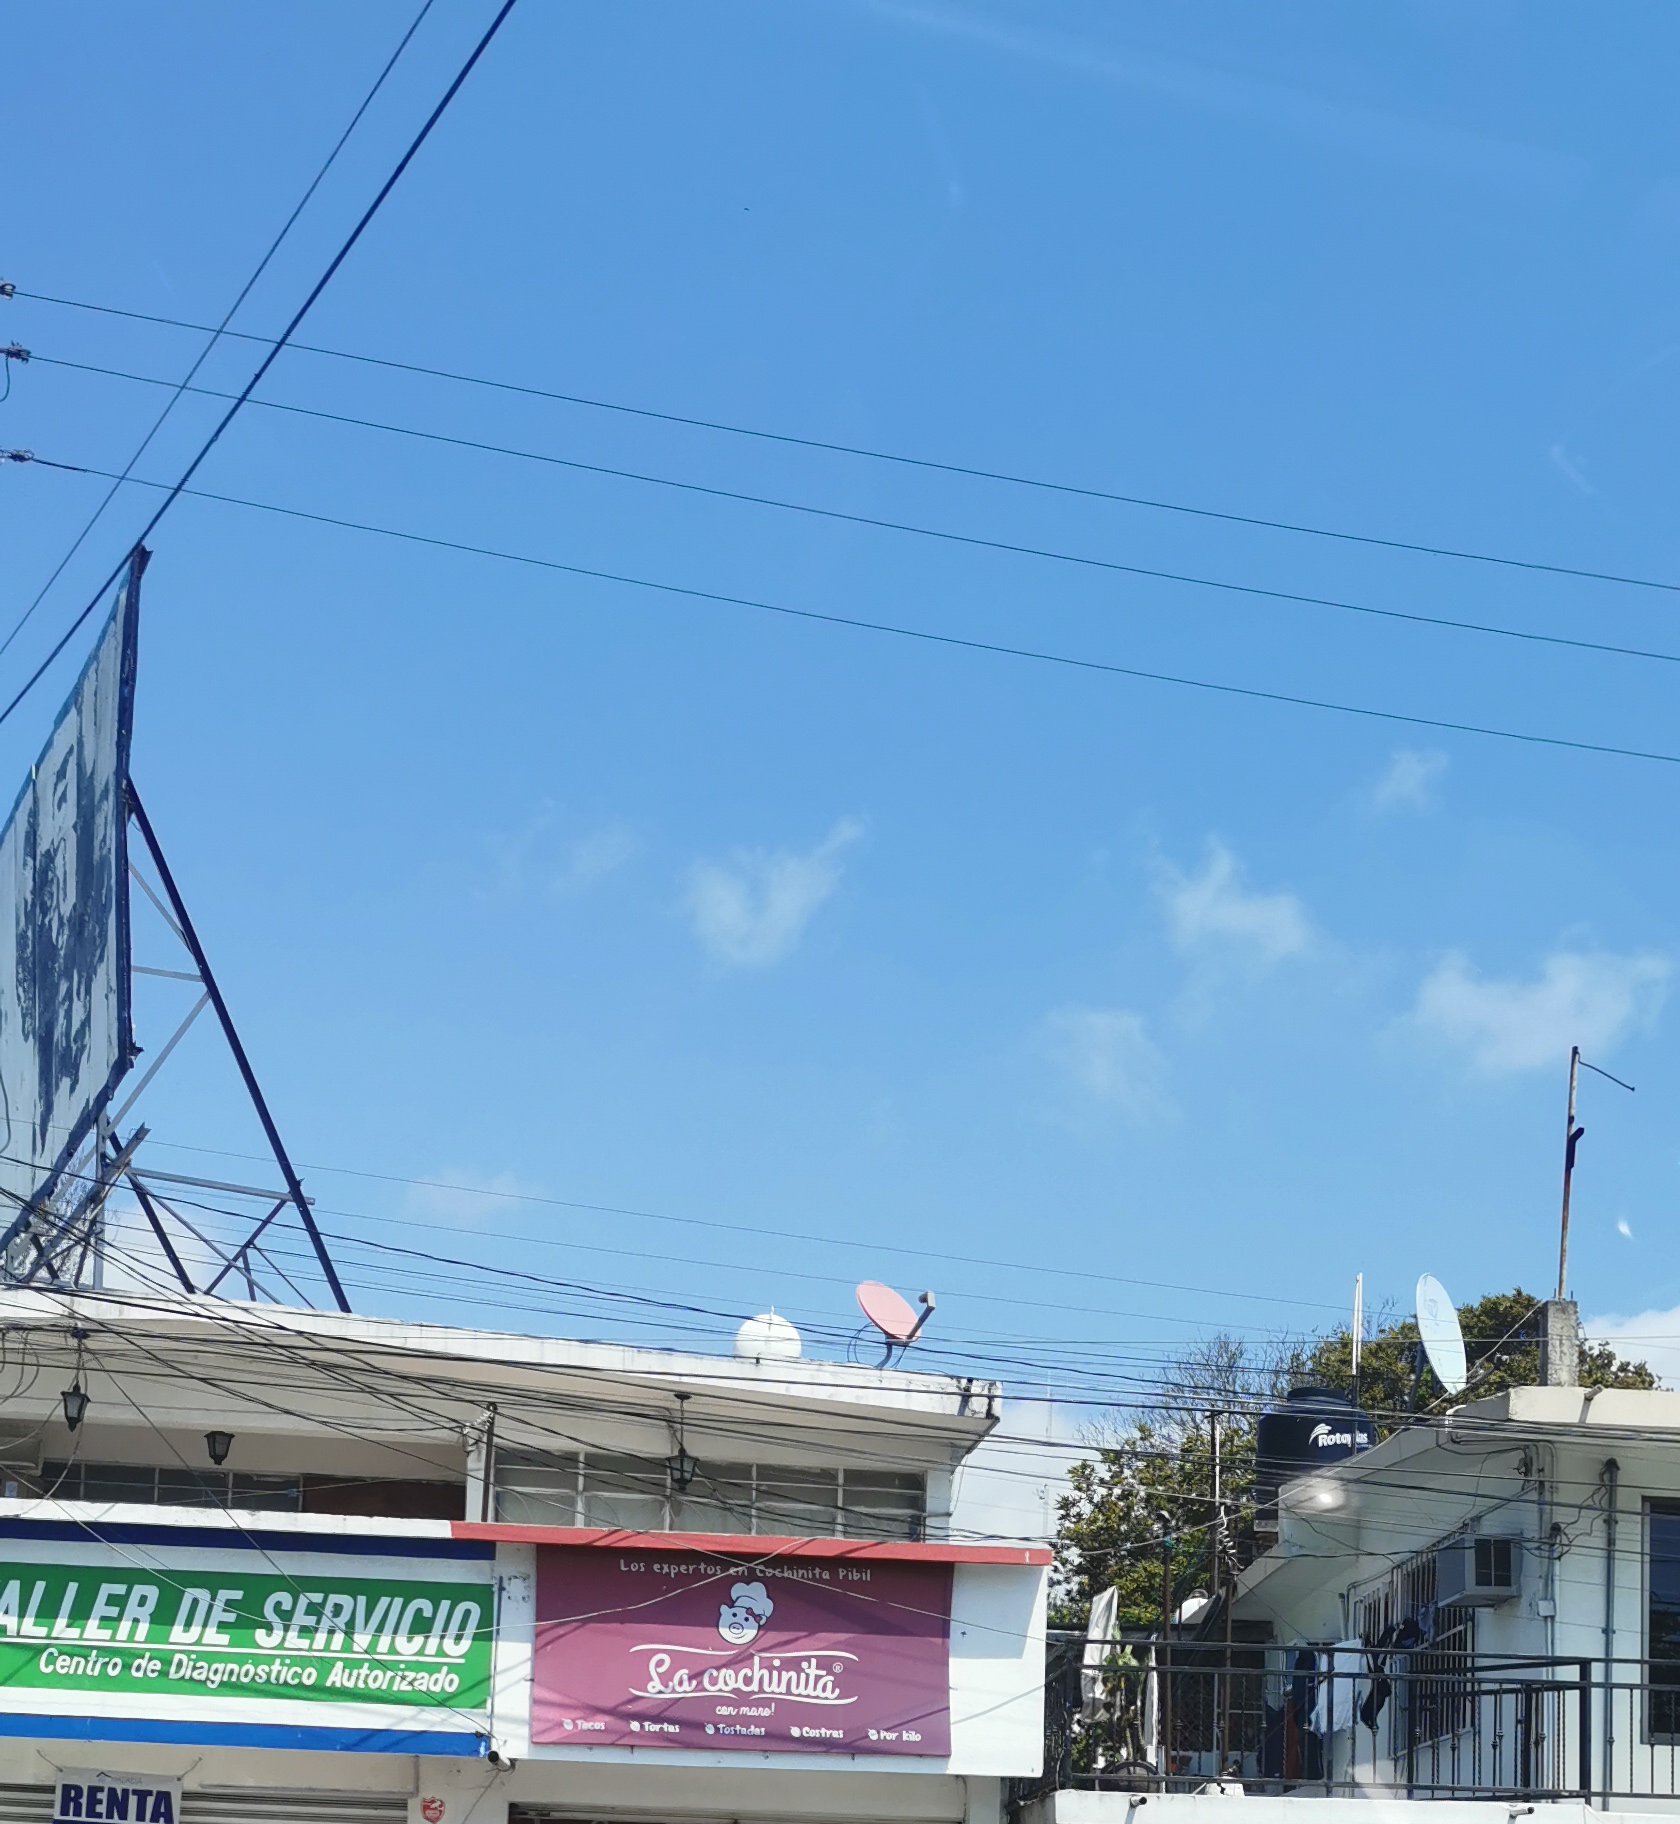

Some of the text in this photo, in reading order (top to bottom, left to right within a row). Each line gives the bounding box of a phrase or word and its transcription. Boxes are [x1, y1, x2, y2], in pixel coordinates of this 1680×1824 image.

[619, 1558, 871, 1582] Los expertos en Cochinita Pibil
[168, 1588, 244, 1646] DE
[254, 1591, 481, 1657] SERVICIO
[38, 1647, 460, 1693] Centro de Diagnóstico Autorizado
[647, 1653, 697, 1693] La
[702, 1655, 840, 1700] cochinita
[575, 1719, 606, 1731] Tacos
[642, 1721, 680, 1733] Tortas
[716, 1723, 766, 1736] Tostadas
[802, 1727, 844, 1739] Costras
[879, 1730, 922, 1742] Por kilo
[60, 1783, 175, 1824] RENTA
